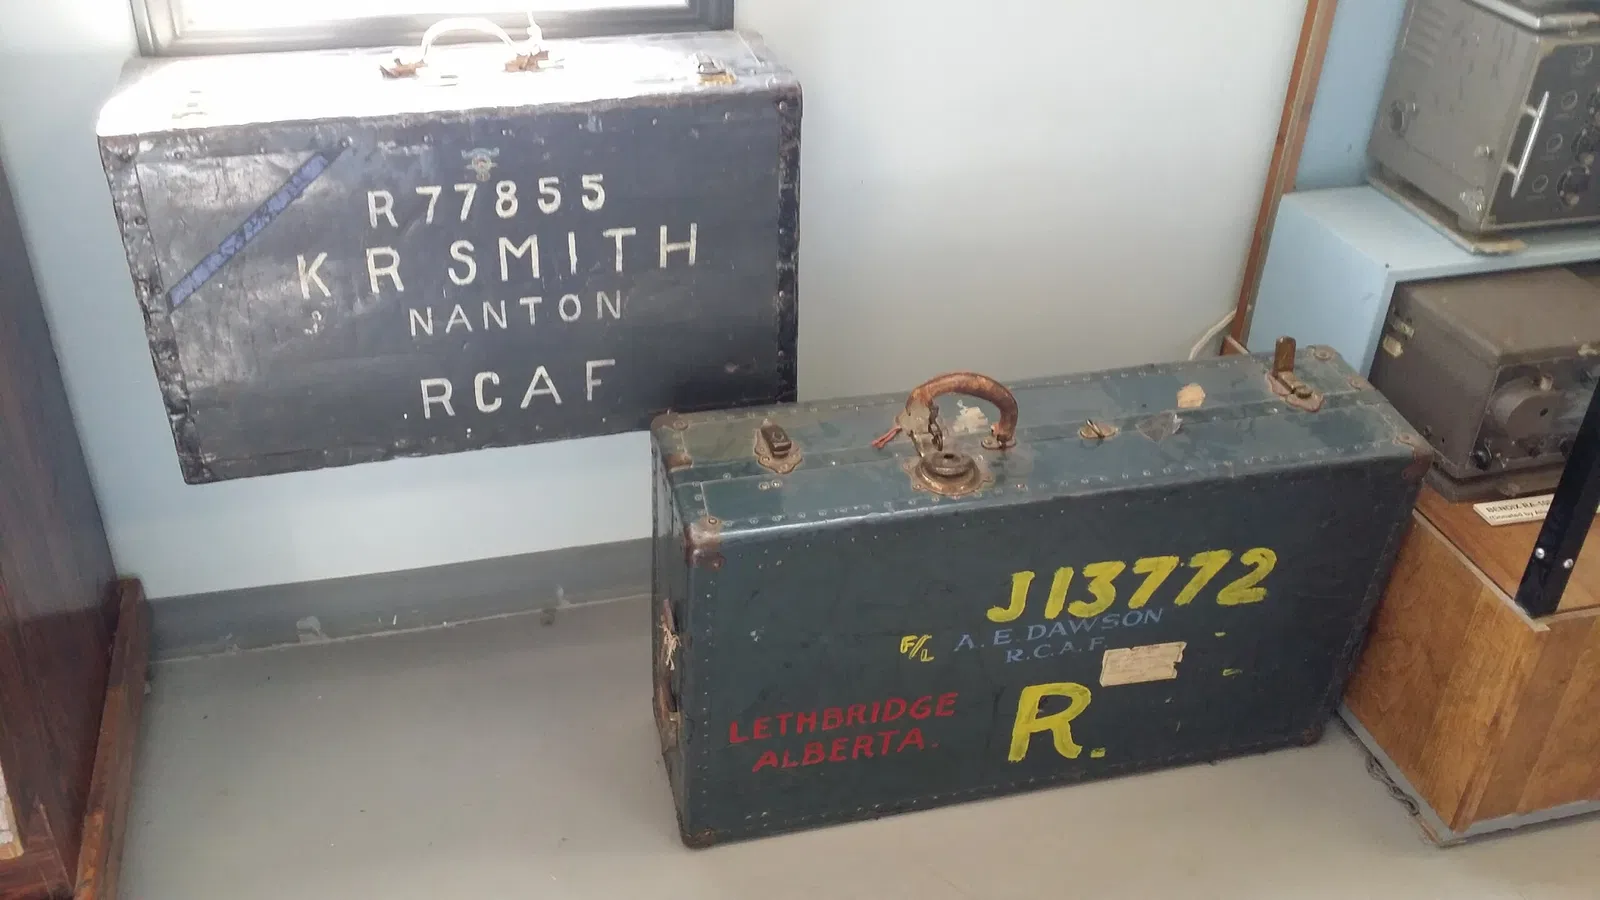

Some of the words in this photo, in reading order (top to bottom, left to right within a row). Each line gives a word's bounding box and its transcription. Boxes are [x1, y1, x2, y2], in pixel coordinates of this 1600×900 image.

[297, 252, 331, 299] K
[366, 246, 404, 294] R
[447, 223, 698, 286] SMITH
[409, 290, 621, 337] NANTON
[420, 359, 616, 419] RCAF
[987, 548, 1277, 622] J13772
[1026, 608, 1164, 641] DAWSON
[728, 692, 958, 744] LETHBRIDGE
